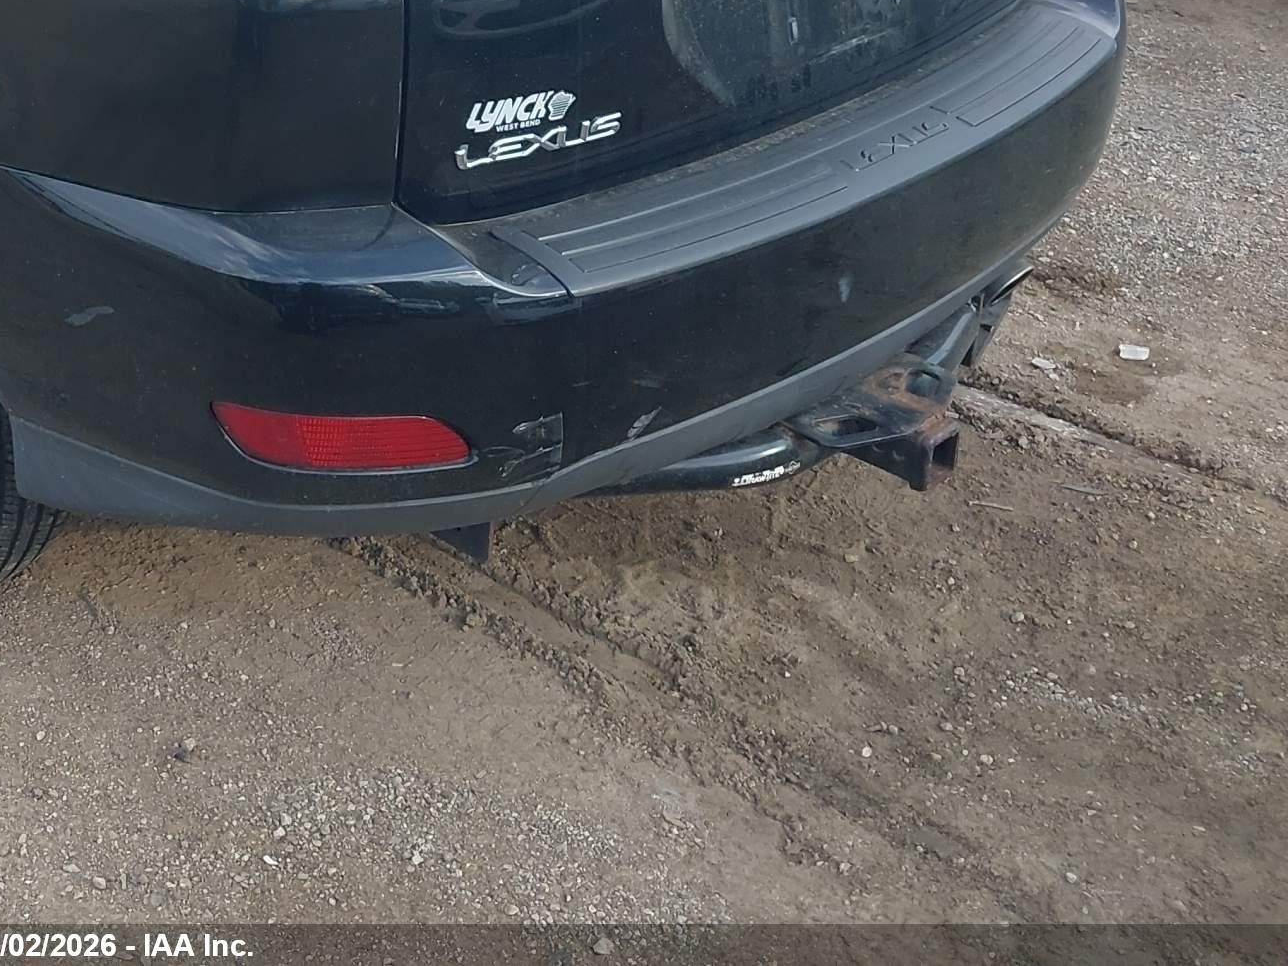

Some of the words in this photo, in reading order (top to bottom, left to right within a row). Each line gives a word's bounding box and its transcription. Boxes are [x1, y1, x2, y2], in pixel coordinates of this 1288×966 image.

[453, 112, 622, 170] LEXUS
[495, 122, 519, 132] WEST
[520, 118, 541, 129] BEND
